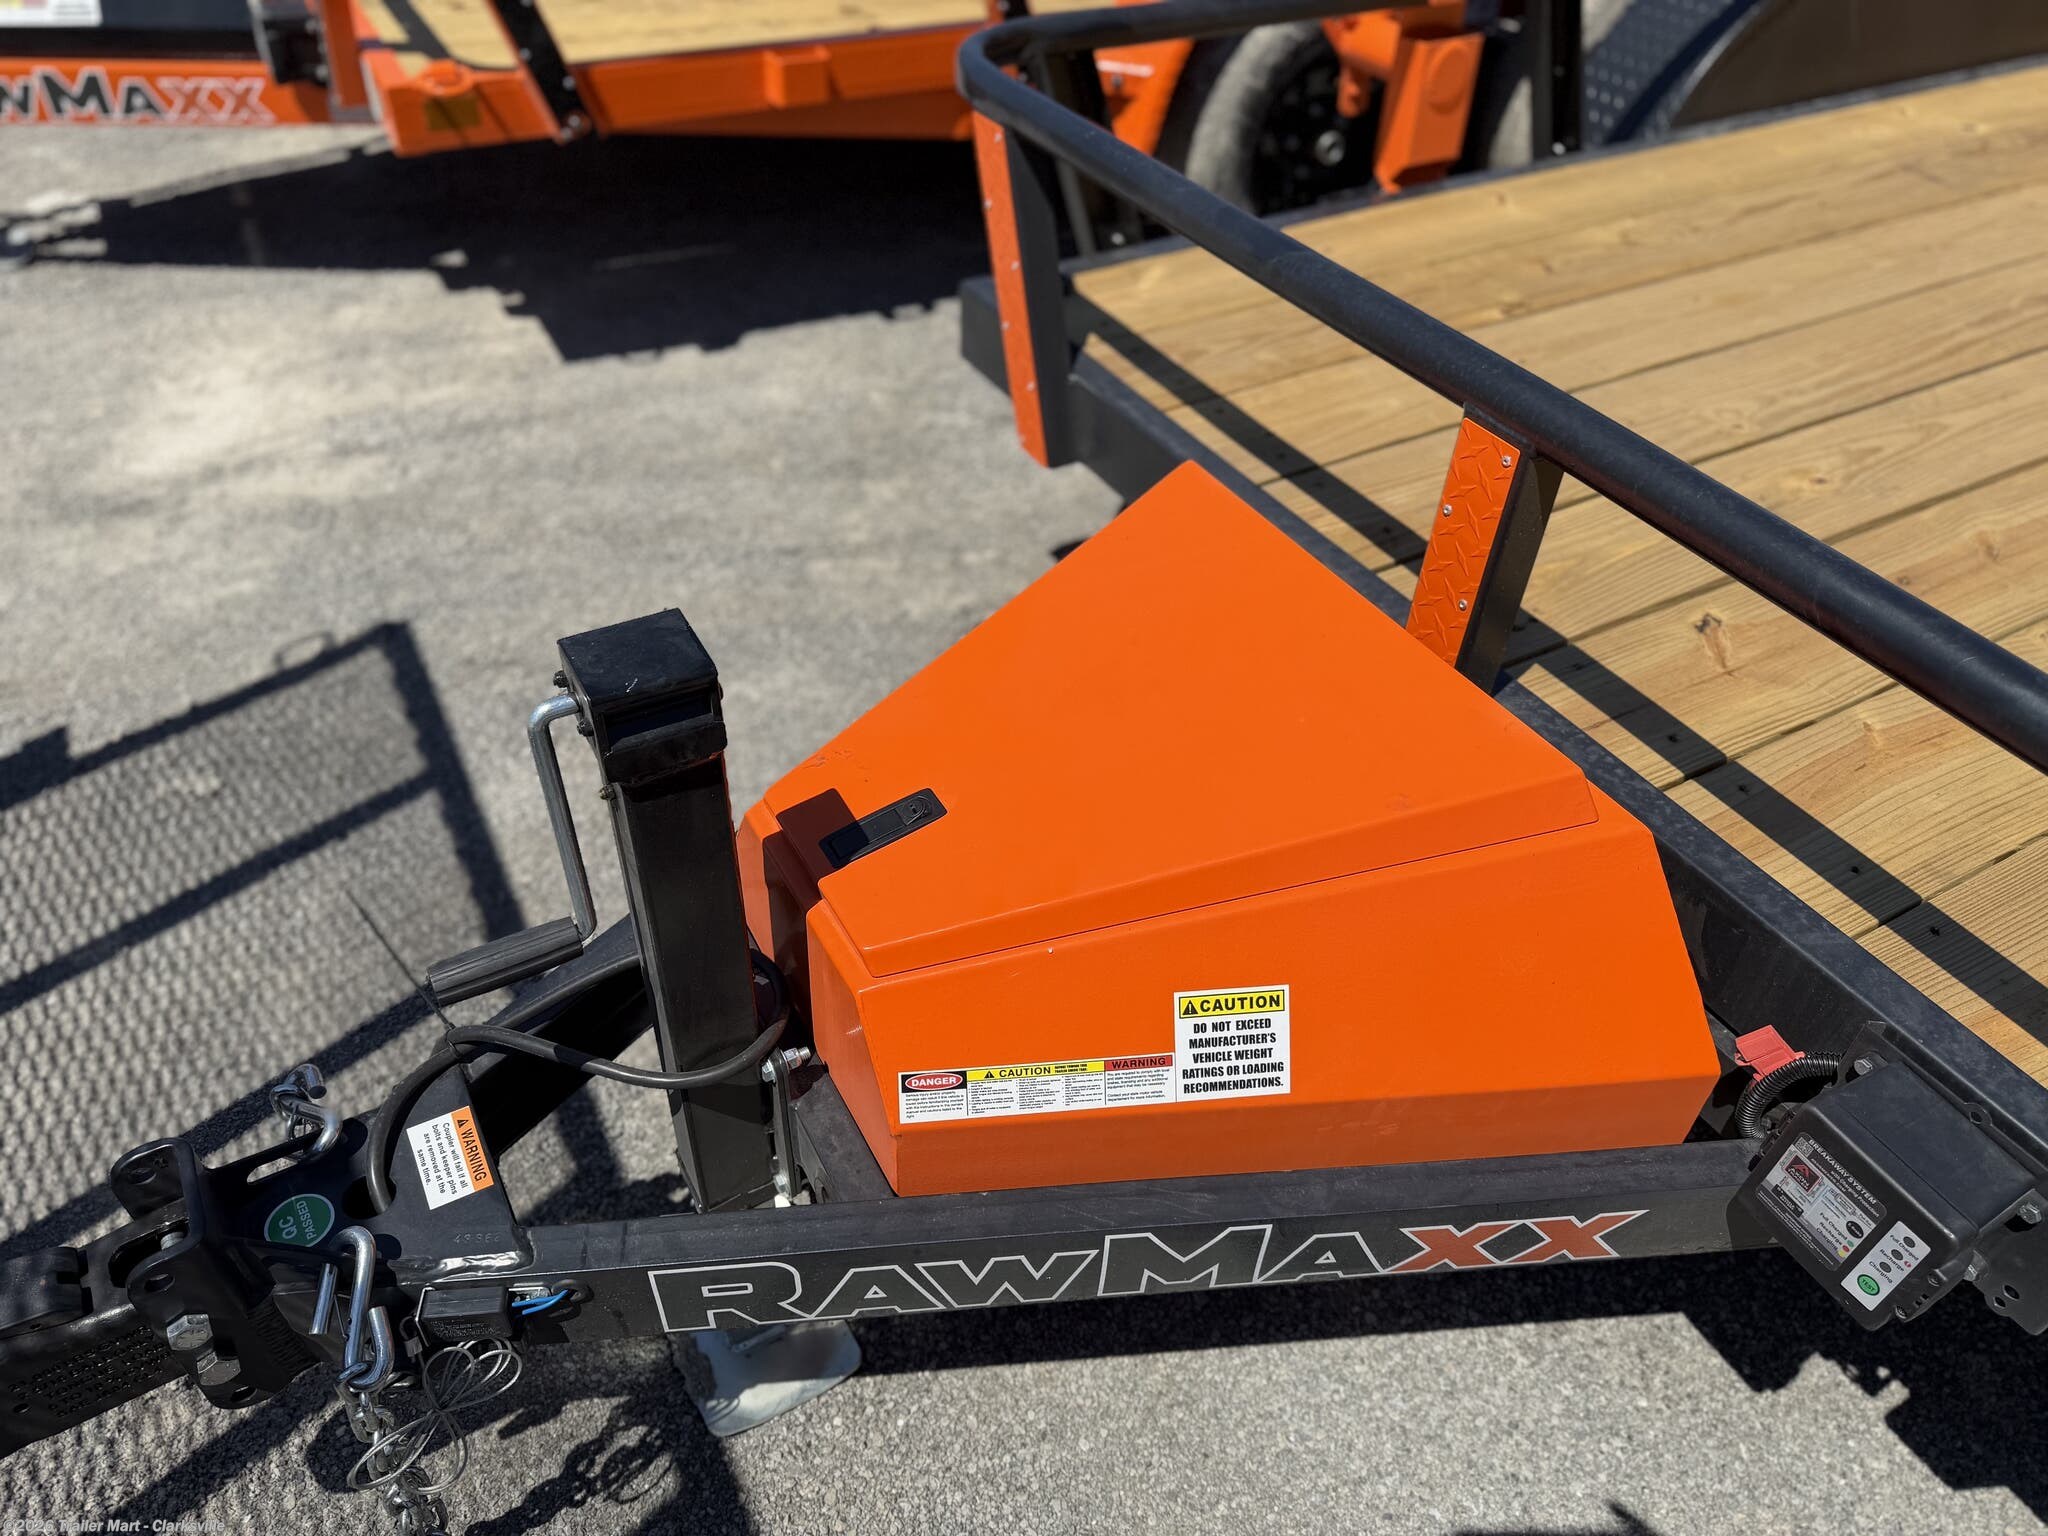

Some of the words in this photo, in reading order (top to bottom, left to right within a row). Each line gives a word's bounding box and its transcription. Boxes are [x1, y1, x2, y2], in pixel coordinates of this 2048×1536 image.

[1200, 995, 1280, 1012] CAUTION
[1194, 1023, 1206, 1033] DO
[1212, 1021, 1231, 1032] NOT
[1236, 1018, 1271, 1030] EXCEED
[1189, 1033, 1276, 1049] MANUFACTURER'S
[1112, 1058, 1165, 1069] WARNING
[1193, 1051, 1232, 1063] VEHICLE
[1234, 1048, 1273, 1060] WEIGHT
[999, 1066, 1050, 1078] CAUTION
[1182, 1067, 1224, 1079] RATINGS
[1227, 1065, 1239, 1075] OR
[1243, 1062, 1284, 1074] LOADING
[911, 1077, 956, 1086] DANGER
[1184, 1077, 1283, 1094] RECOMMENDATIONS.
[432, 1124, 441, 1141] bolts
[437, 1142, 447, 1154] and
[443, 1122, 455, 1148] Coupler
[450, 1149, 460, 1161] will
[460, 1180, 468, 1188] all
[461, 1128, 487, 1181] WARNING
[417, 1149, 426, 1167] same
[427, 1145, 441, 1174] removed
[441, 1154, 453, 1178] keeper
[1809, 1139, 1849, 1177] BREAKAWAY
[1848, 1177, 1876, 1204] SYSTEM
[446, 1179, 458, 1194] pins
[279, 1216, 297, 1239] QC
[296, 1200, 317, 1240] PASSED
[648, 1210, 1649, 1332] RAWMAXX
[1862, 1278, 1875, 1291] TEST
